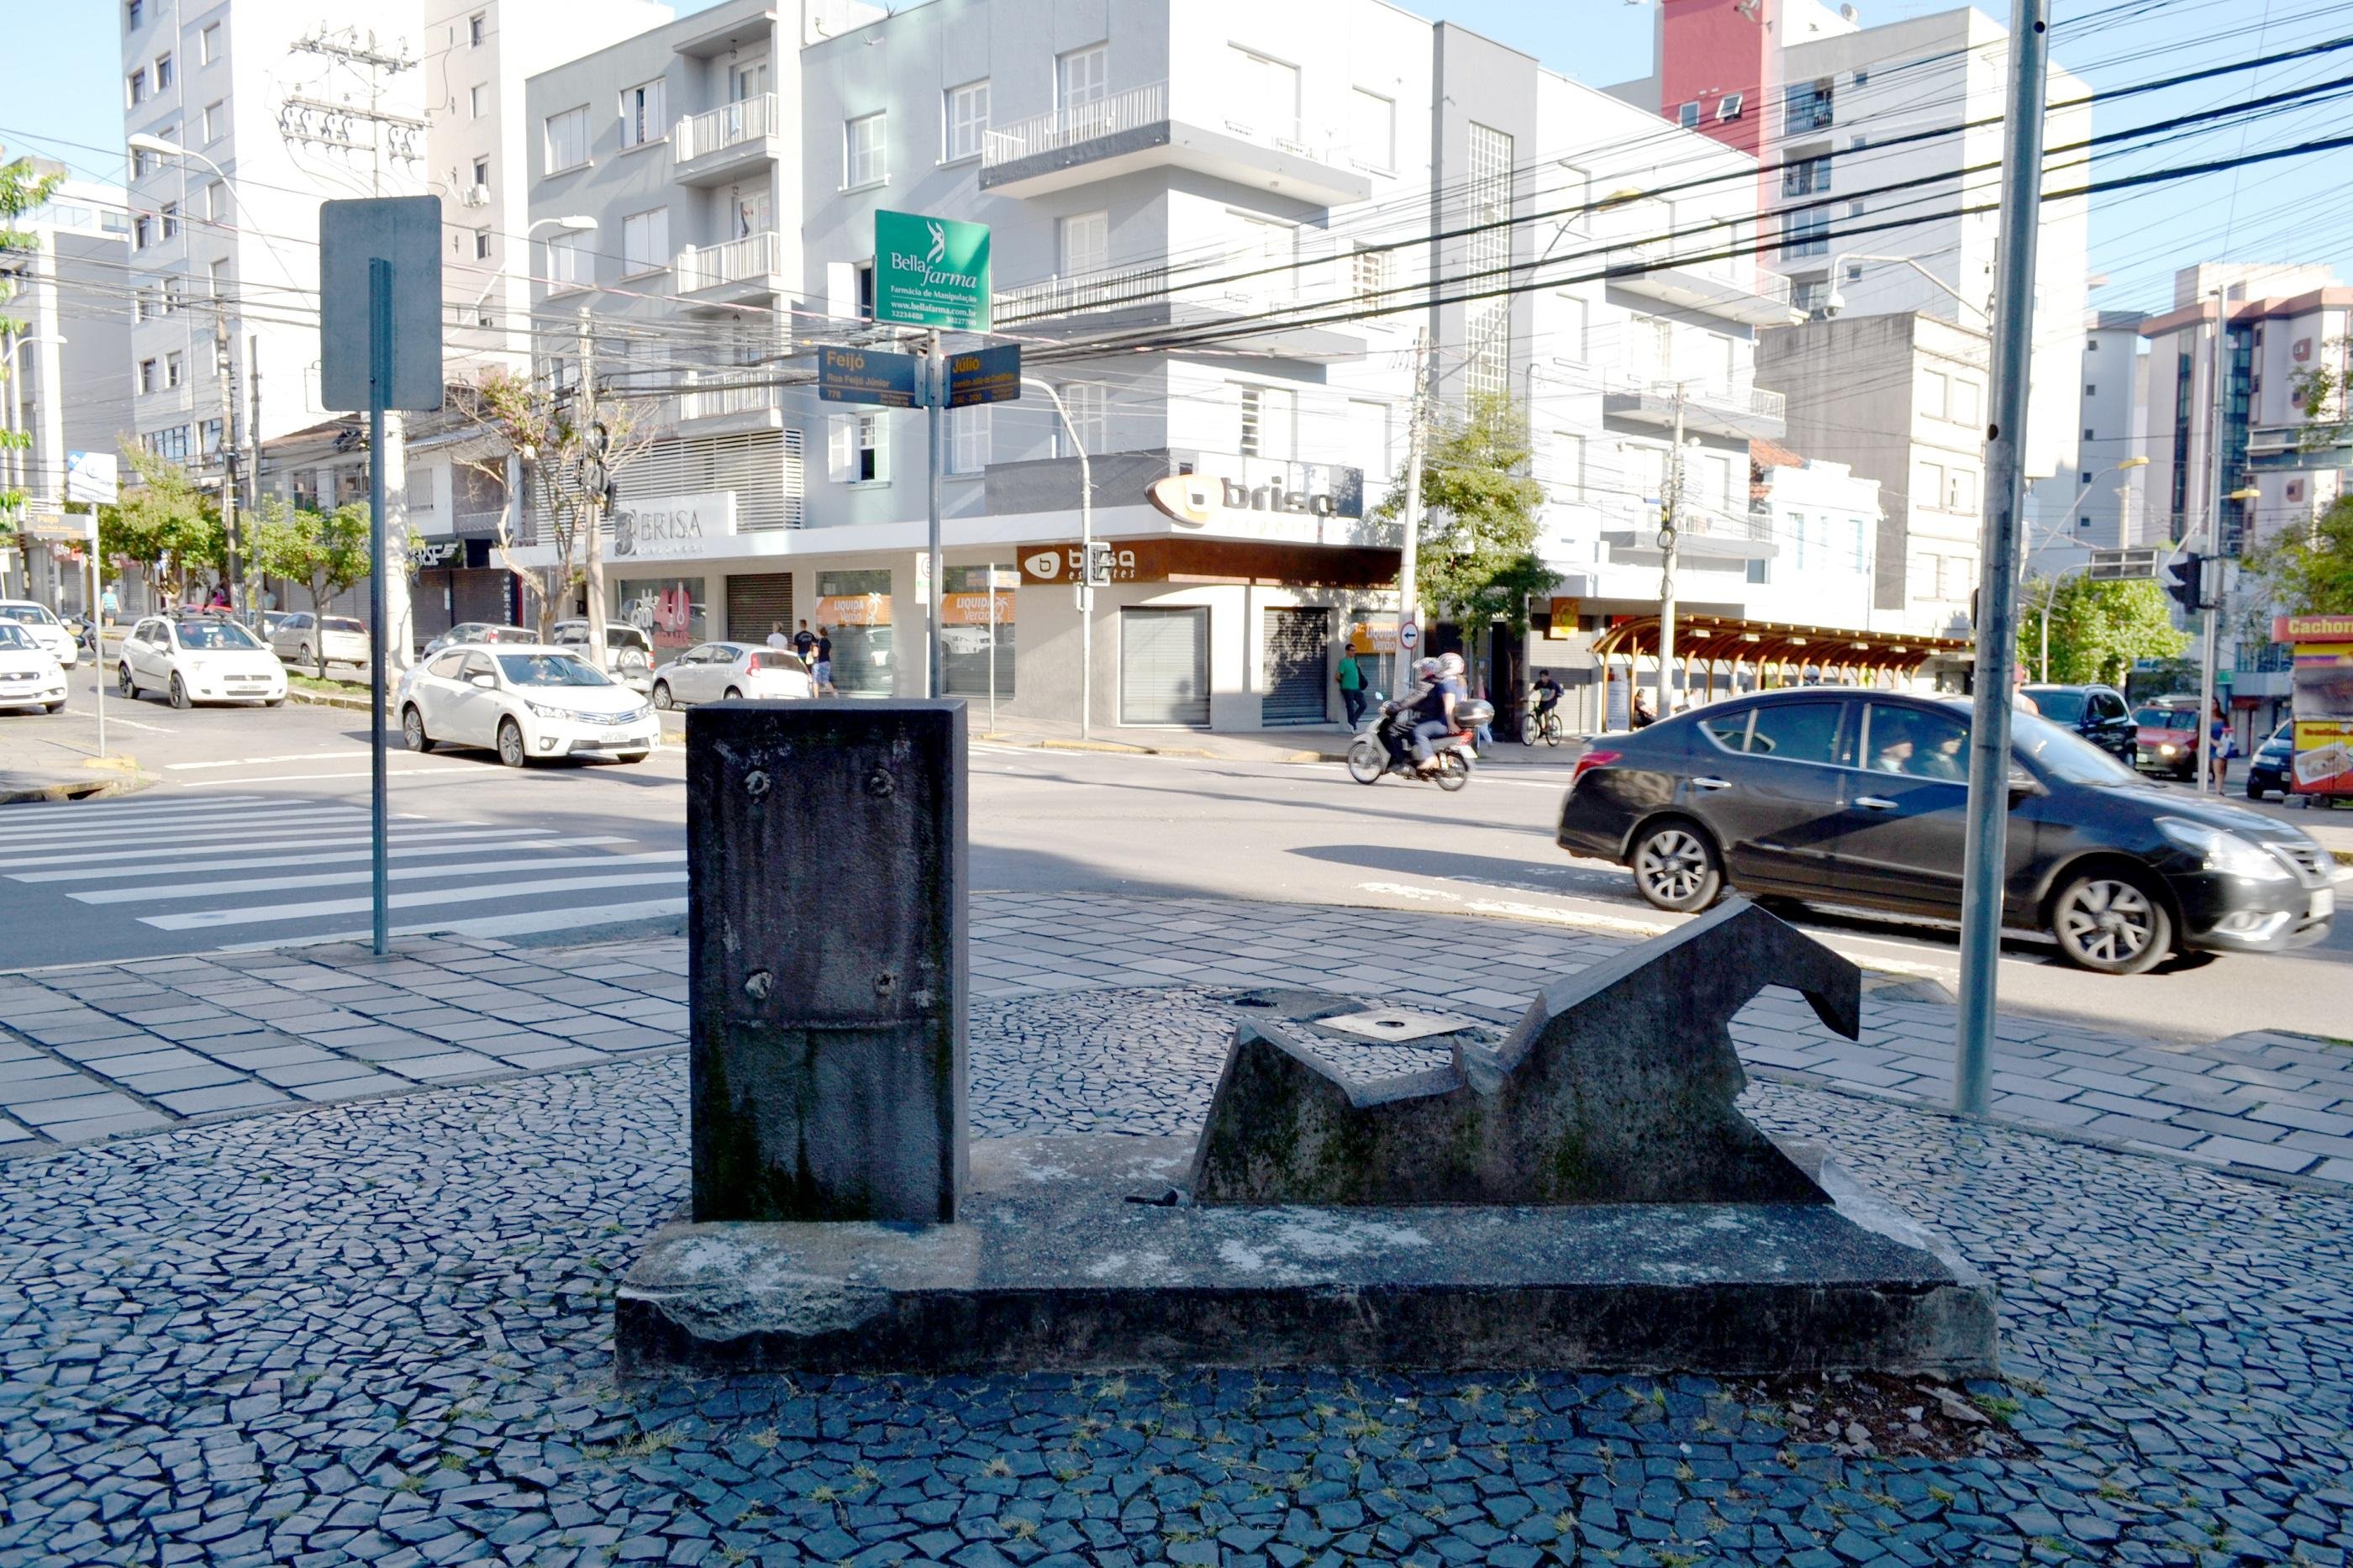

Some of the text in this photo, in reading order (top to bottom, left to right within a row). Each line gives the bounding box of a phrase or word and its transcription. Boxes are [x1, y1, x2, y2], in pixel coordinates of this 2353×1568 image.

[891, 252, 977, 289] Bella farma
[891, 286, 976, 303] Farmácia de Manipulação
[891, 303, 976, 317] www.bellafarma.com.br
[826, 350, 865, 371] Feijó
[952, 357, 980, 374] Júlio
[827, 373, 890, 388] Rua Feijó Júnior
[1220, 476, 1338, 518] brisa
[641, 509, 703, 540] BRISA
[1068, 549, 1135, 568] bsa
[1068, 569, 1135, 580] estes
[834, 600, 864, 612] LIQUIDA
